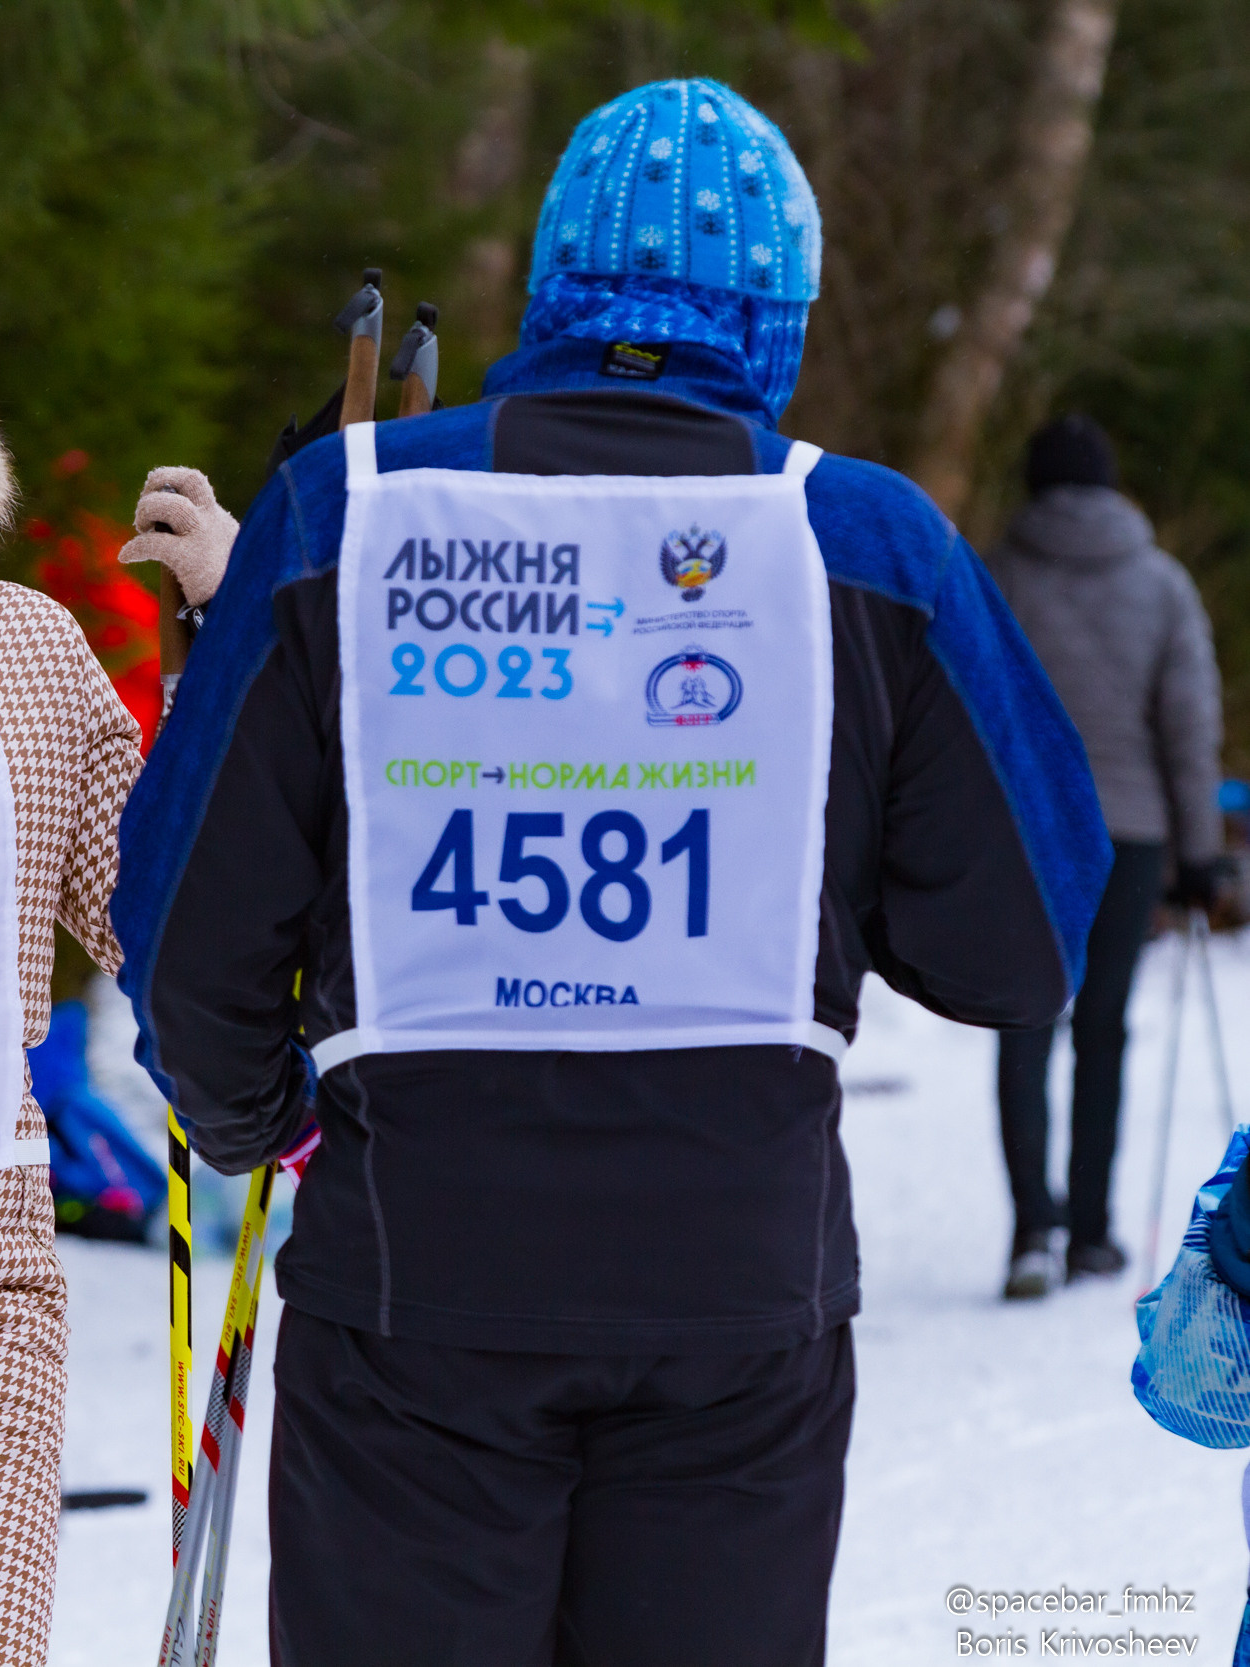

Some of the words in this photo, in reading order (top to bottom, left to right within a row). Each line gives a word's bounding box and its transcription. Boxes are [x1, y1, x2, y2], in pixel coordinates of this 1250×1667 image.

[383, 537, 581, 585] ЛЫЖНЯ
[386, 588, 580, 635] РОССИИ
[388, 642, 574, 700] 2023
[385, 759, 482, 788] СПОРТ
[509, 760, 631, 791] НОРМА
[637, 760, 756, 790] ЖИЗНИ
[411, 808, 710, 942] 4581
[495, 976, 640, 1008] МОСКВА
[224, 1221, 252, 1343] WWW.STC-SKI.RU
[177, 1361, 185, 1476] WWW.STC-SKI.RU
